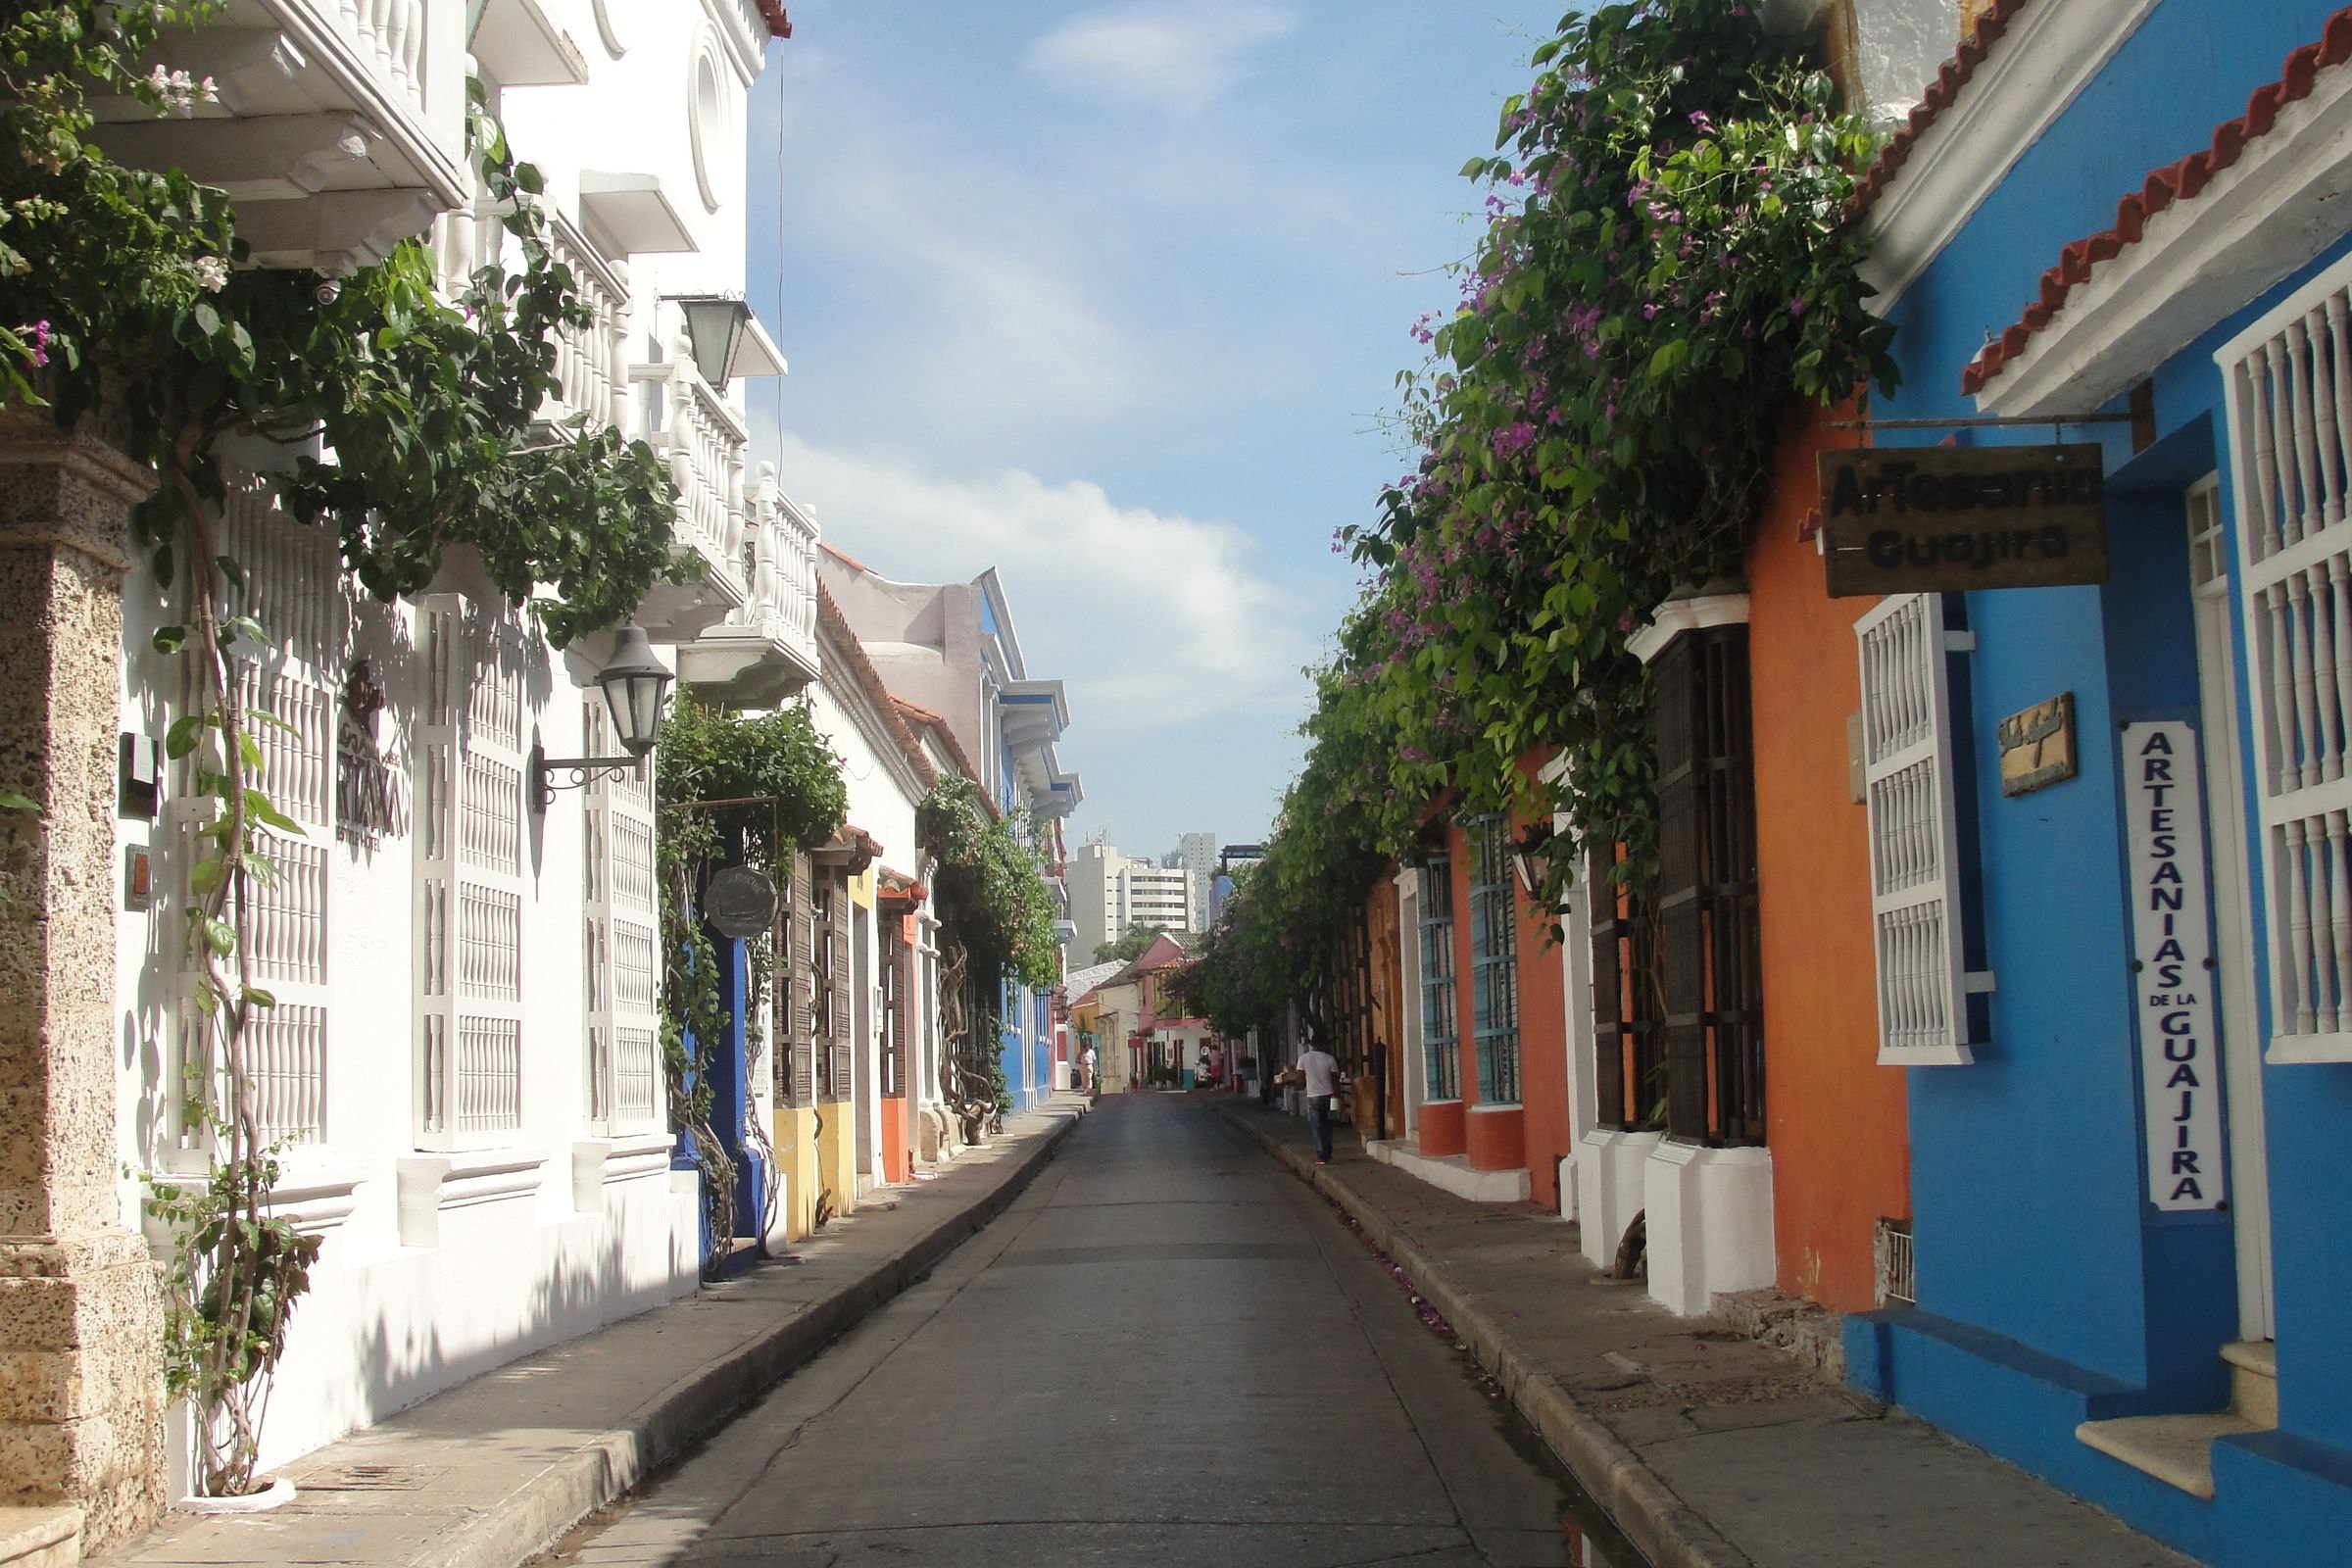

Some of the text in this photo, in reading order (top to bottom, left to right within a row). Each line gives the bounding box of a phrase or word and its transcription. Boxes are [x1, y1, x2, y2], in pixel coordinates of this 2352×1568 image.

[361, 833, 381, 853] HOTEL
[2140, 731, 2185, 988] ARTESANIAS
[2149, 993, 2197, 1006] DE LA
[2160, 1011, 2203, 1200] GUAJIRA
